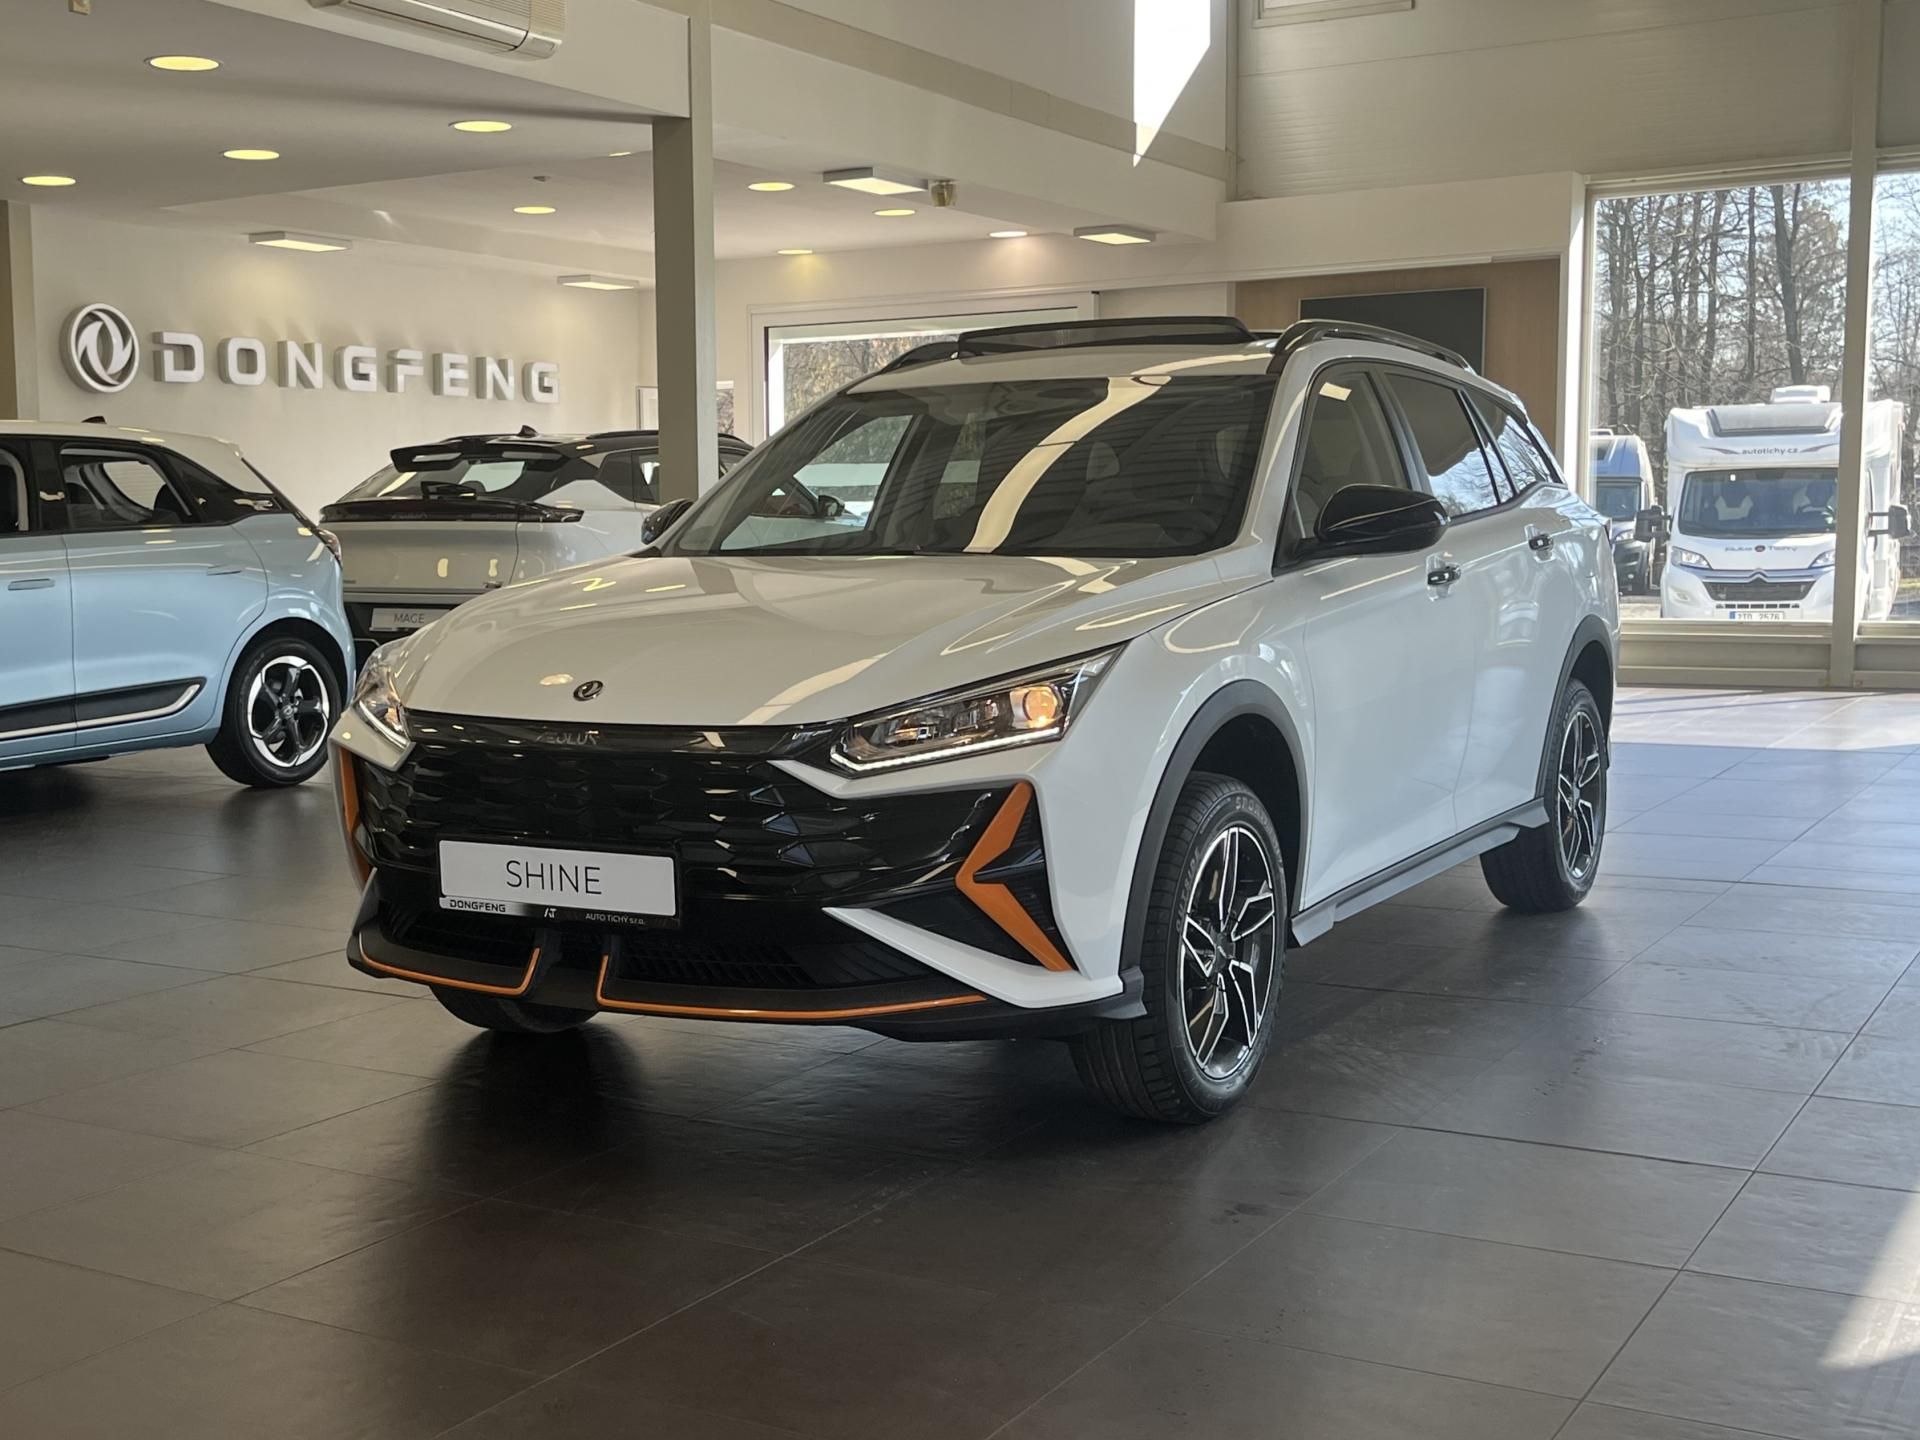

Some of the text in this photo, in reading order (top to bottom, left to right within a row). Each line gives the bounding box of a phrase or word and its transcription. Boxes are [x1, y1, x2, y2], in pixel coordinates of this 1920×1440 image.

[152, 331, 560, 404] DONGFENG
[394, 612, 425, 624] MAGE
[506, 860, 602, 895] SHINE
[449, 900, 506, 913] DONGFENG
[585, 913, 606, 922] AUTO
